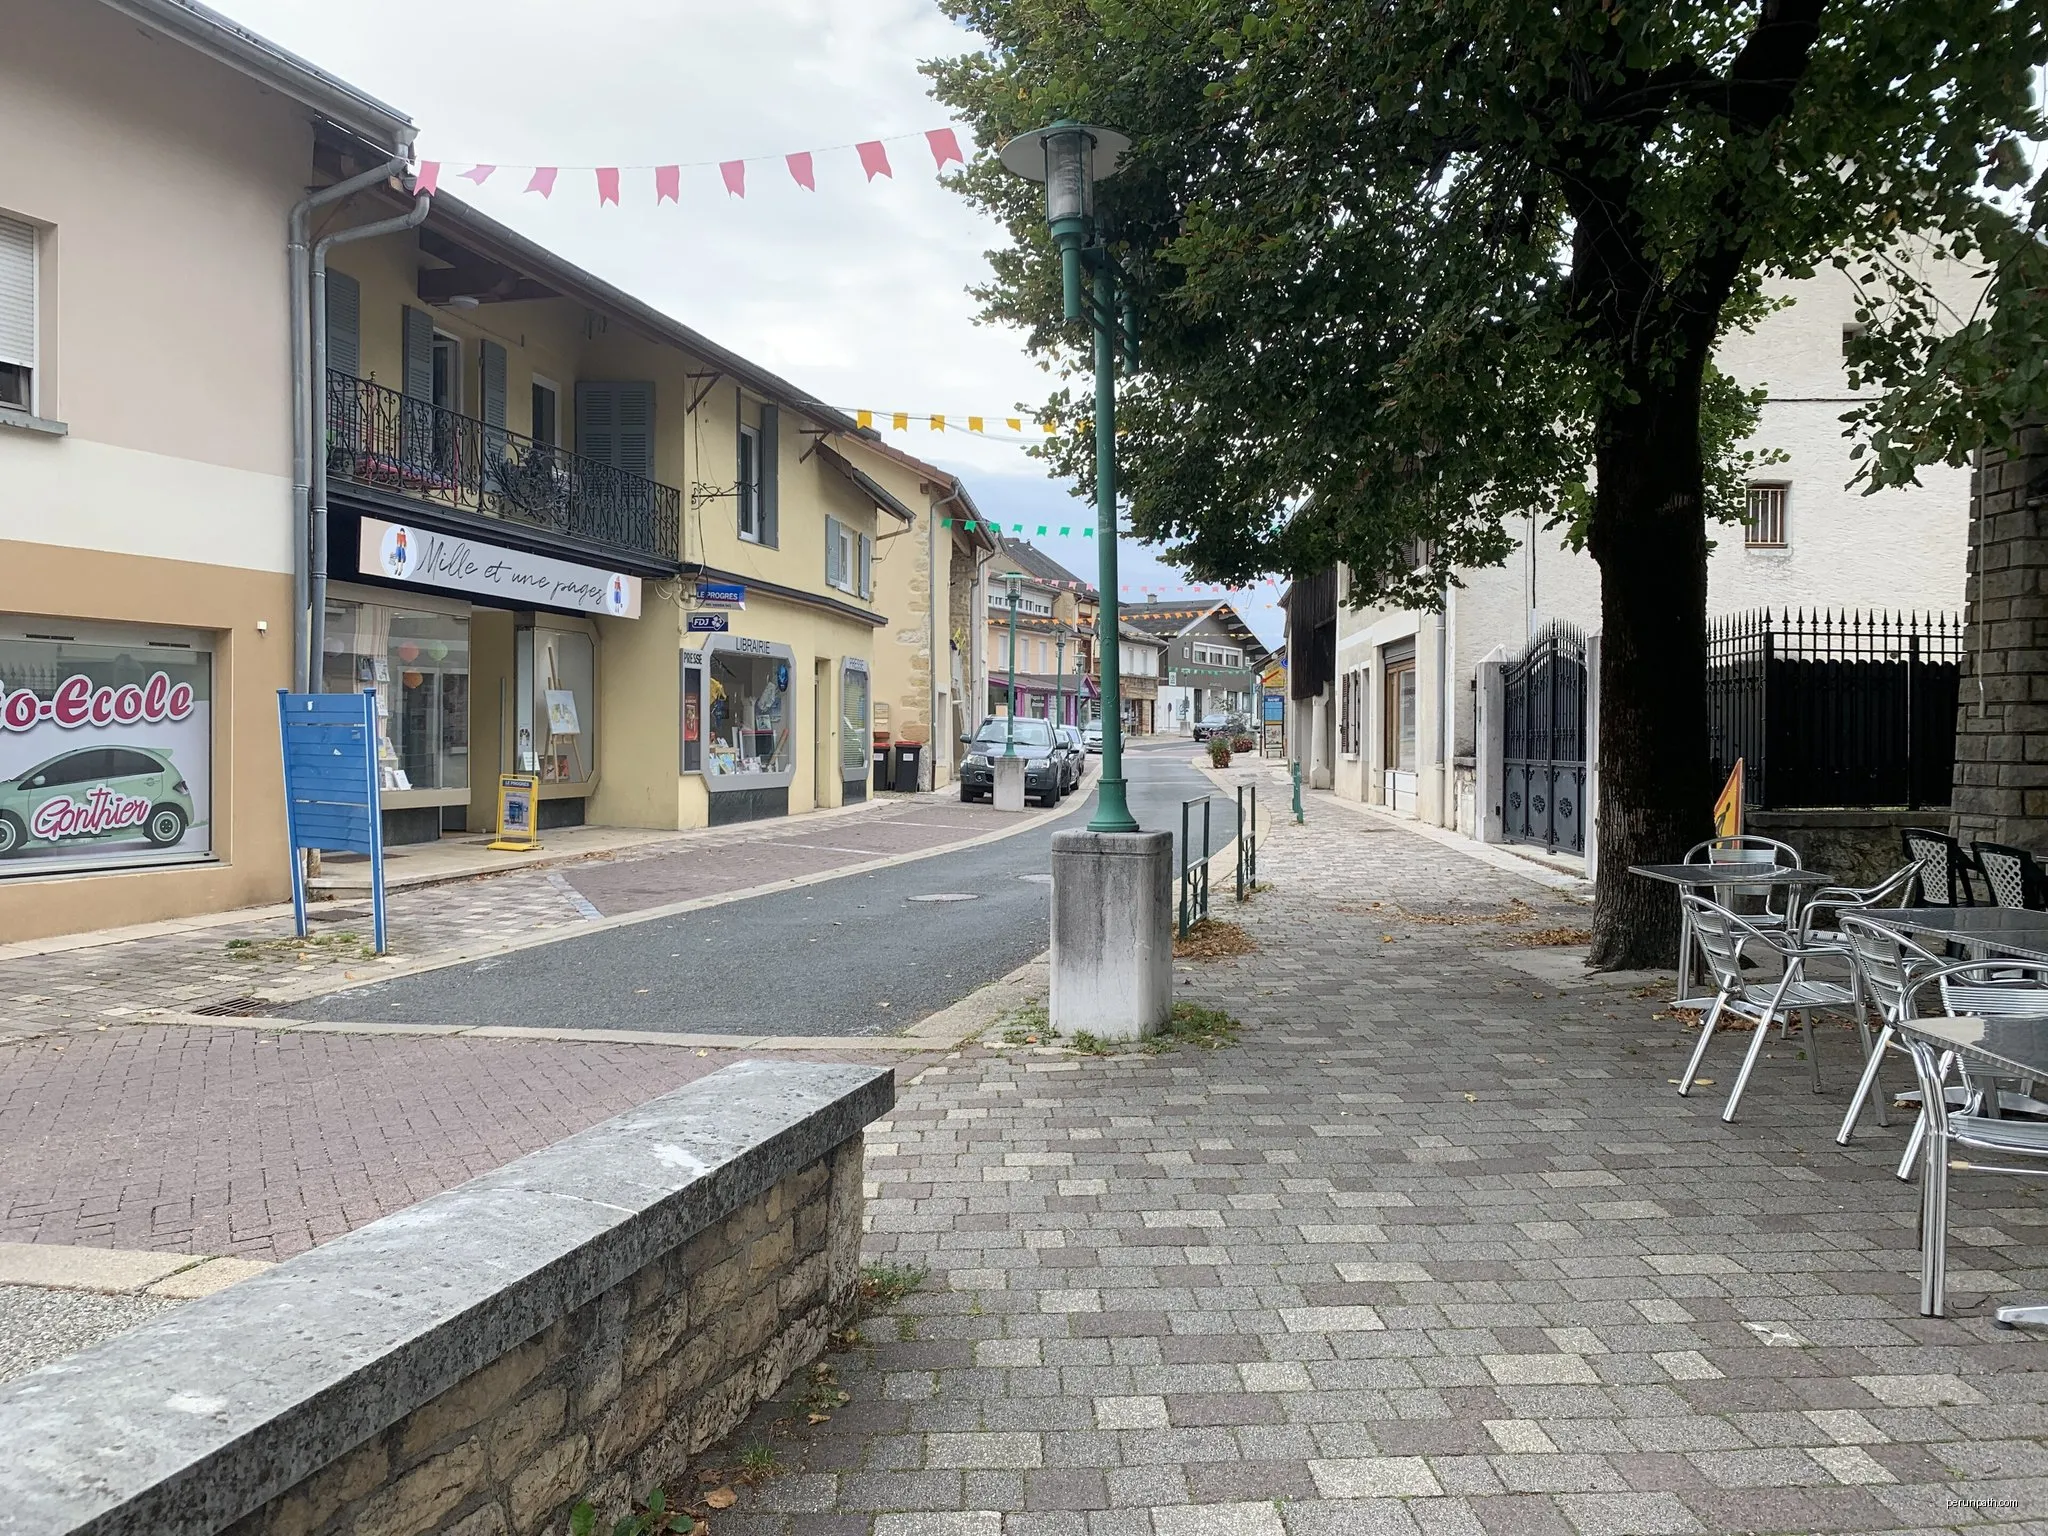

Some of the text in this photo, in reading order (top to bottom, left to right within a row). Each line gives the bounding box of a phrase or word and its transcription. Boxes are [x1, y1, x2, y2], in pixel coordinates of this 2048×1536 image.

[416, 536, 606, 605] Mille et une pages
[694, 618, 709, 626] FDJ
[683, 652, 703, 665] PRESSE
[736, 637, 771, 654] LIBRAIRIE
[0, 672, 193, 729] o-Ecole
[32, 786, 151, 838] Gonthier
